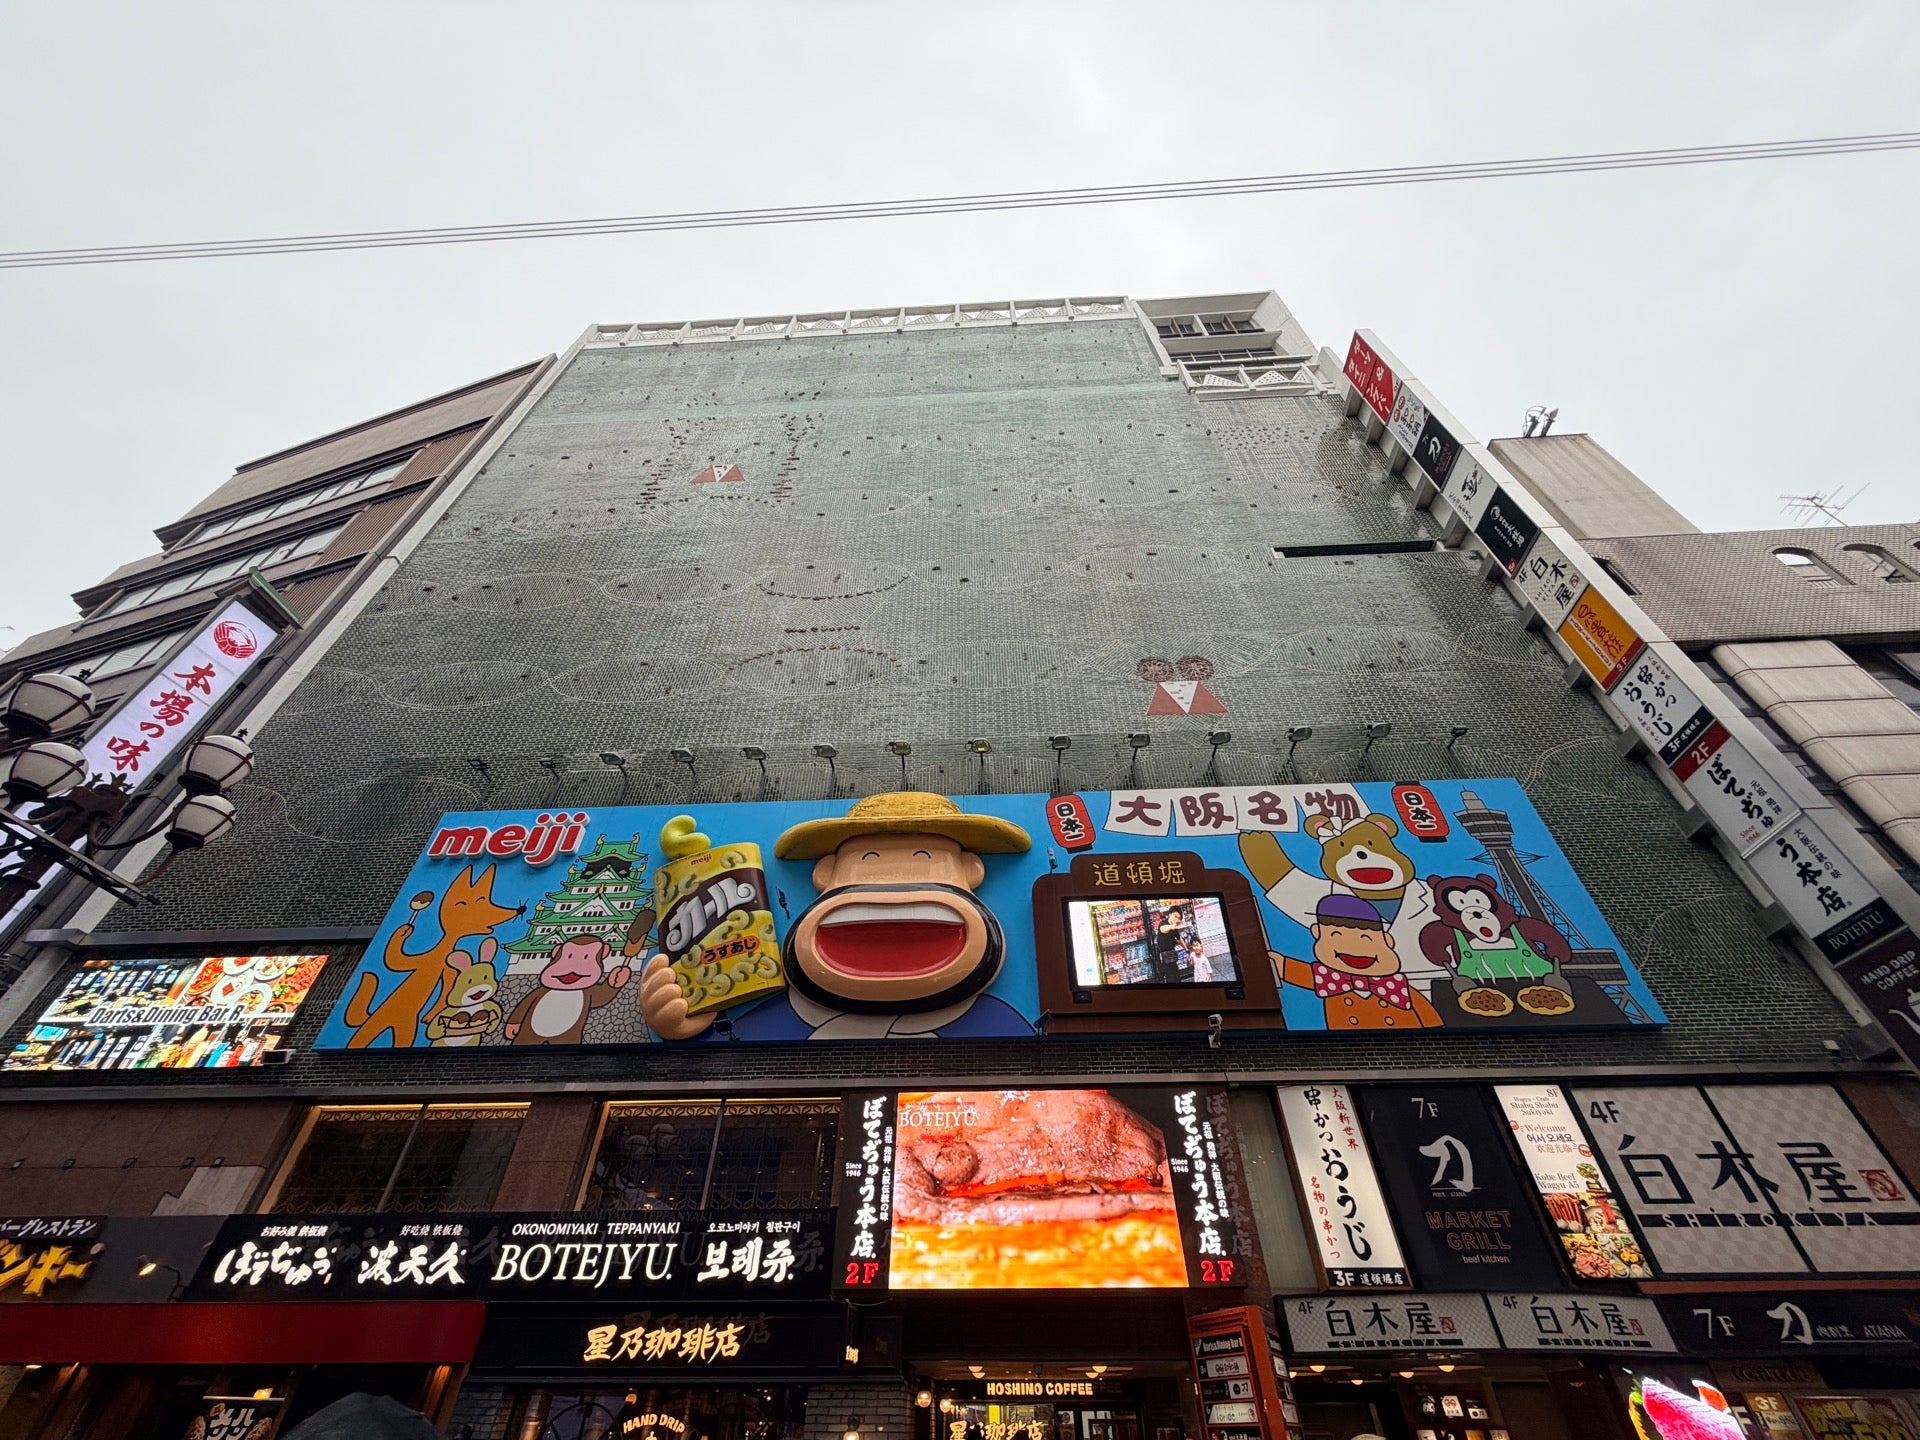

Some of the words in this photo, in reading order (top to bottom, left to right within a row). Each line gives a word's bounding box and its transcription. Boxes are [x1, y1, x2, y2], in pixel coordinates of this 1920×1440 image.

[1519, 568, 1528, 584] 4F
[1530, 556, 1575, 610] 白木屋
[1616, 656, 1628, 671] 3F
[1637, 665, 1677, 707] 串かつ
[106, 662, 216, 772] 本場の味
[1623, 682, 1673, 736] おうじ
[1667, 738, 1681, 753] 3F
[1691, 742, 1710, 765] 2F
[1114, 789, 1362, 827] 大阪名物
[1403, 790, 1437, 832] 日本一
[1054, 800, 1085, 842] 日本一
[427, 811, 590, 868] meiji
[1739, 825, 1755, 839] Since
[690, 855, 712, 866] meiji
[1094, 860, 1186, 886] 道頓堀
[665, 877, 757, 952] カール
[703, 937, 758, 963] うすあじ
[1860, 964, 1891, 985] HAND
[1890, 950, 1917, 969] DRIP
[1876, 964, 1920, 991] COFFEE
[89, 1005, 196, 1026] Darts&Dining
[1546, 1088, 1560, 1098] 8F
[1333, 1087, 1359, 1150] 大阪新世界
[1411, 1097, 1439, 1120] 7F
[1520, 1109, 1554, 1117] Sukiyaki
[1590, 1101, 1621, 1124] 4F
[884, 1126, 893, 1144] 元祖
[1202, 1121, 1213, 1140] 元祖
[1524, 1124, 1566, 1133] Welcome
[1526, 1133, 1546, 1143] 어서
[1546, 1133, 1574, 1143] 오세요
[845, 1162, 862, 1170] Since
[1171, 1158, 1188, 1166] Since
[1173, 1165, 1189, 1173] 1946
[1617, 1134, 1873, 1204] 白木屋
[846, 1169, 861, 1177] 1946
[1534, 1172, 1556, 1181] Kobe
[1557, 1172, 1576, 1181] Beef
[1537, 1181, 1567, 1190] Wagyu
[1568, 1181, 1580, 1189] A5
[707, 1221, 760, 1234] 오코노미야키
[765, 1221, 800, 1233] 철판구이
[1310, 1175, 1341, 1259] 名物の串かつ
[1425, 1211, 1511, 1229] MARKET
[511, 1222, 598, 1236] OKONOMIYAKI
[607, 1222, 680, 1235] TEPPANYAKI
[1446, 1231, 1512, 1250] GRILL
[357, 1240, 467, 1285] 波天久
[1462, 1255, 1480, 1263] beef
[1481, 1254, 1511, 1263] kitchen
[845, 1262, 879, 1285] 2F
[1200, 1259, 1234, 1282] 2F
[1334, 1270, 1354, 1287] 3F
[1359, 1272, 1404, 1286] 道頓堀店
[1298, 1301, 1314, 1314] 4F
[1502, 1295, 1518, 1310] 4F
[1325, 1300, 1441, 1337] 白木屋
[1530, 1295, 1634, 1336] 白木屋
[1692, 1308, 1736, 1339] 7F
[583, 1322, 746, 1364] 星乃珈琲店
[986, 1382, 1043, 1396] HOSHINO
[1045, 1382, 1093, 1396] COFFEE
[623, 1414, 658, 1434] HAND
[658, 1413, 686, 1434] DRIP
